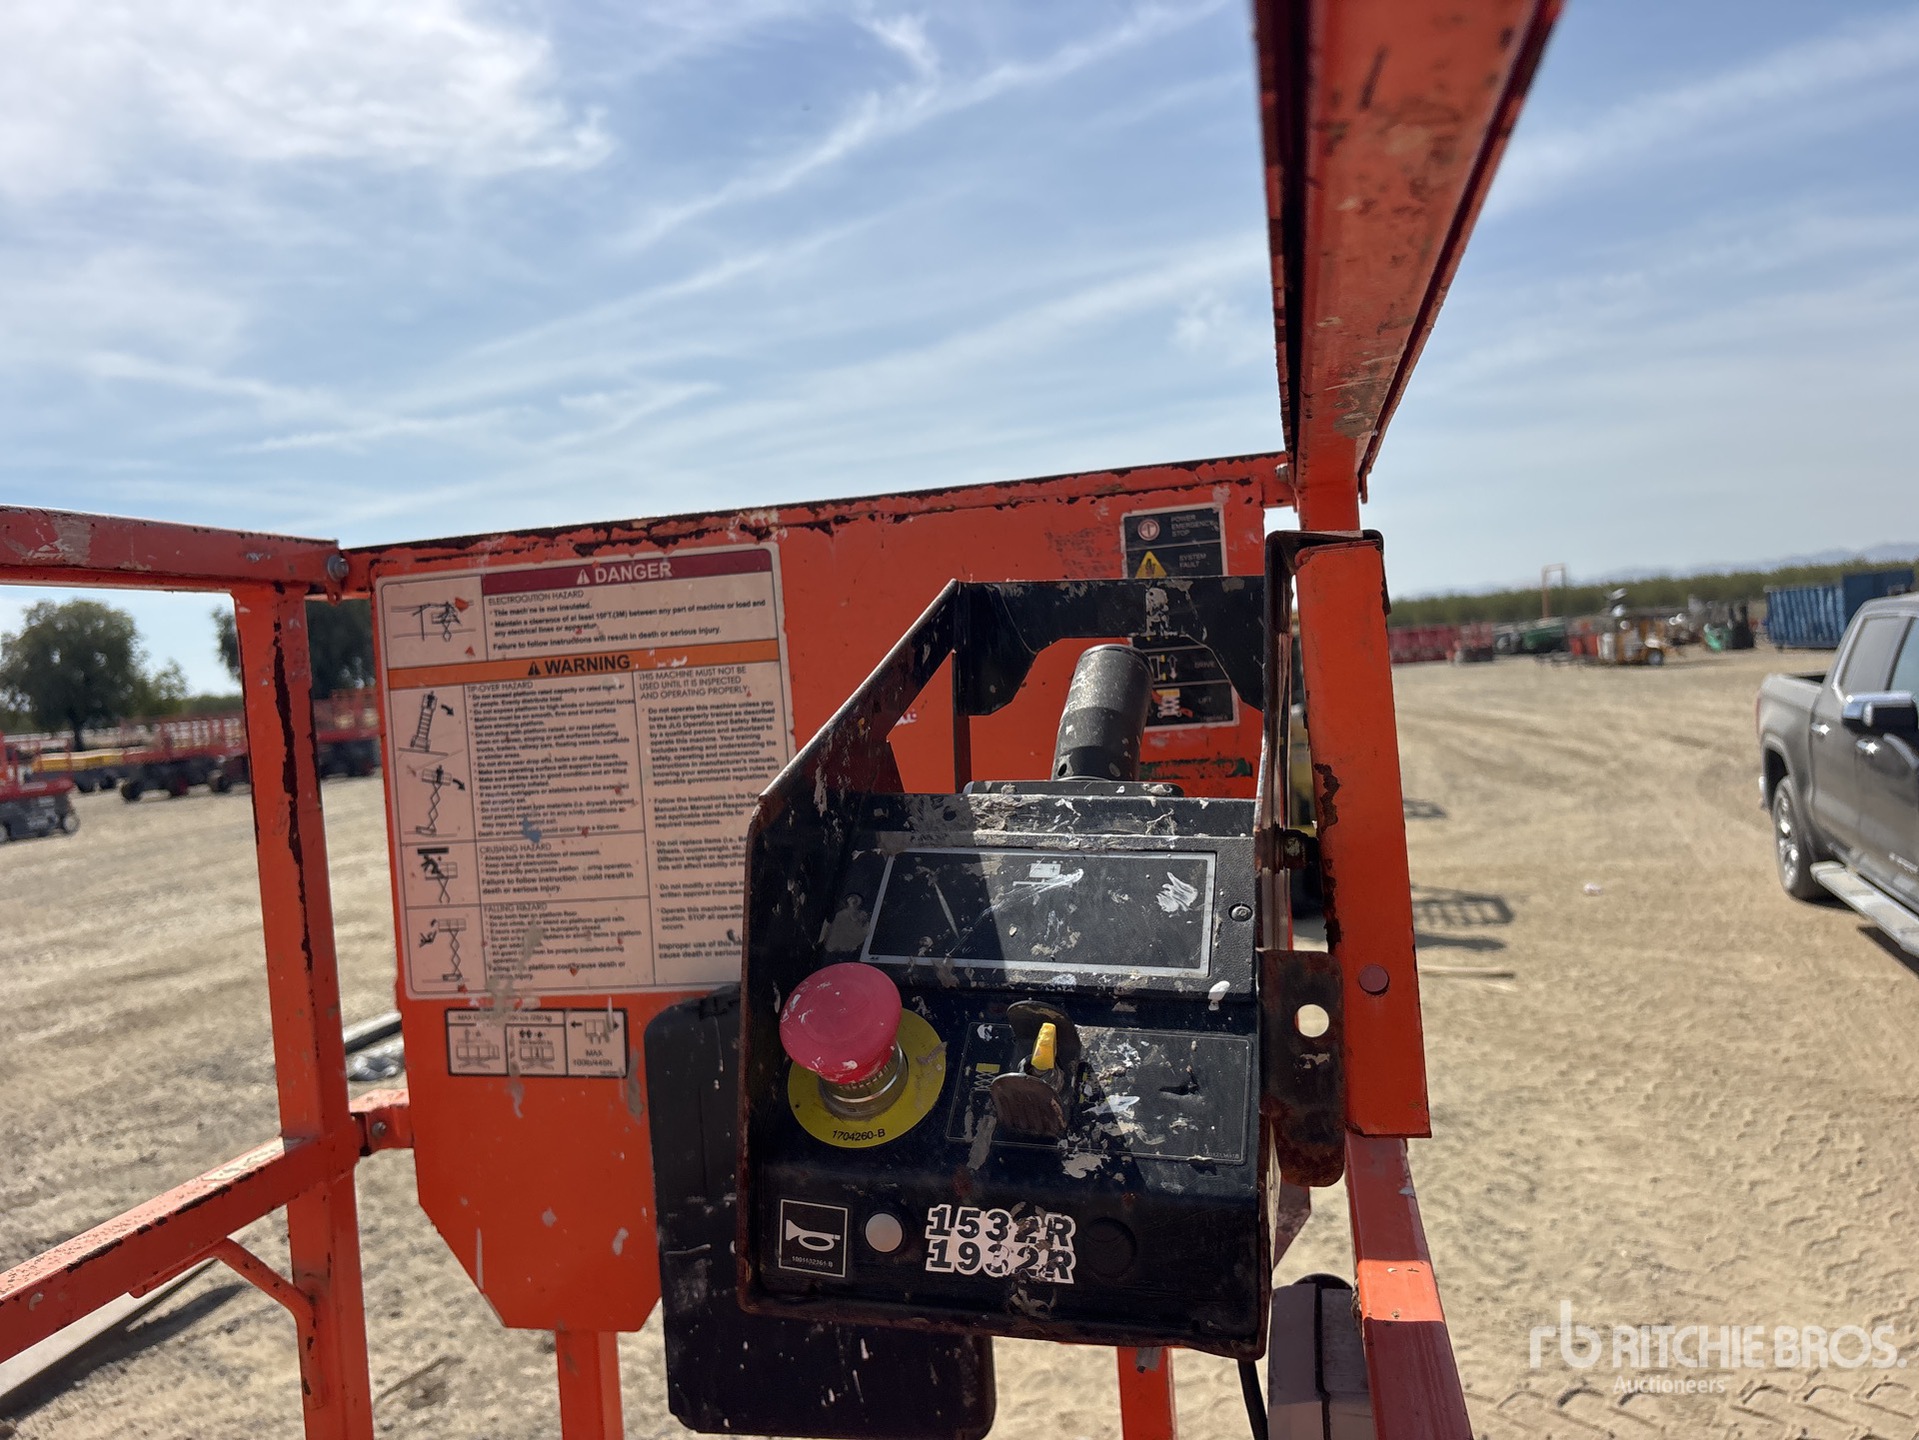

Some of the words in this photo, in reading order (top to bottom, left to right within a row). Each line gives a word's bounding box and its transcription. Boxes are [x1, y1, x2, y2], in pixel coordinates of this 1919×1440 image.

[1172, 529, 1190, 537] STOP
[1179, 553, 1207, 561] SYSTEM
[1180, 560, 1200, 568] FAULT
[594, 561, 672, 583] DANGER
[488, 593, 550, 605] ELECTROCUTION
[551, 590, 583, 600] HAZARD
[494, 619, 522, 627] Maintain
[529, 616, 560, 624] clearance
[628, 608, 657, 616] between
[658, 608, 671, 616] any
[672, 606, 686, 615] part
[696, 603, 724, 611] machine
[752, 599, 765, 607] and
[492, 641, 516, 649] Failure
[527, 639, 548, 647] follow
[549, 636, 591, 645] instructions
[607, 633, 628, 641] result
[638, 630, 659, 639] death
[669, 628, 696, 636] serious
[698, 626, 720, 636] injury.
[494, 630, 505, 638] any
[506, 627, 537, 635] electrical
[538, 625, 554, 633] lines
[544, 654, 630, 674] WARNING
[655, 669, 693, 679] MACHINE
[694, 668, 716, 676] MUST
[717, 666, 734, 674] NOT
[639, 681, 659, 690] USED
[660, 680, 682, 688] UNTIL
[683, 679, 689, 687] IT
[698, 675, 741, 685] INSPECTED
[640, 691, 658, 700] AND
[659, 688, 705, 698] OPERATING
[670, 705, 695, 714] operate
[682, 712, 709, 721] properly
[743, 707, 775, 715] described
[729, 717, 750, 726] Safety
[649, 731, 657, 739] by
[664, 729, 692, 738] qualified
[730, 724, 765, 732] authorized
[650, 738, 674, 747] operate
[735, 733, 761, 741] training
[679, 744, 703, 753] reading
[718, 741, 765, 751] understanding
[673, 752, 704, 761] operating
[718, 749, 760, 757] maintenance
[651, 761, 690, 769] instructions
[698, 758, 747, 766] manufacturer's
[652, 770, 680, 778] knowing
[696, 767, 730, 776] employers
[653, 777, 686, 786] applicable
[687, 775, 731, 784] governmental
[833, 1129, 886, 1141] 1704260-B
[926, 1204, 1076, 1249] 1532R
